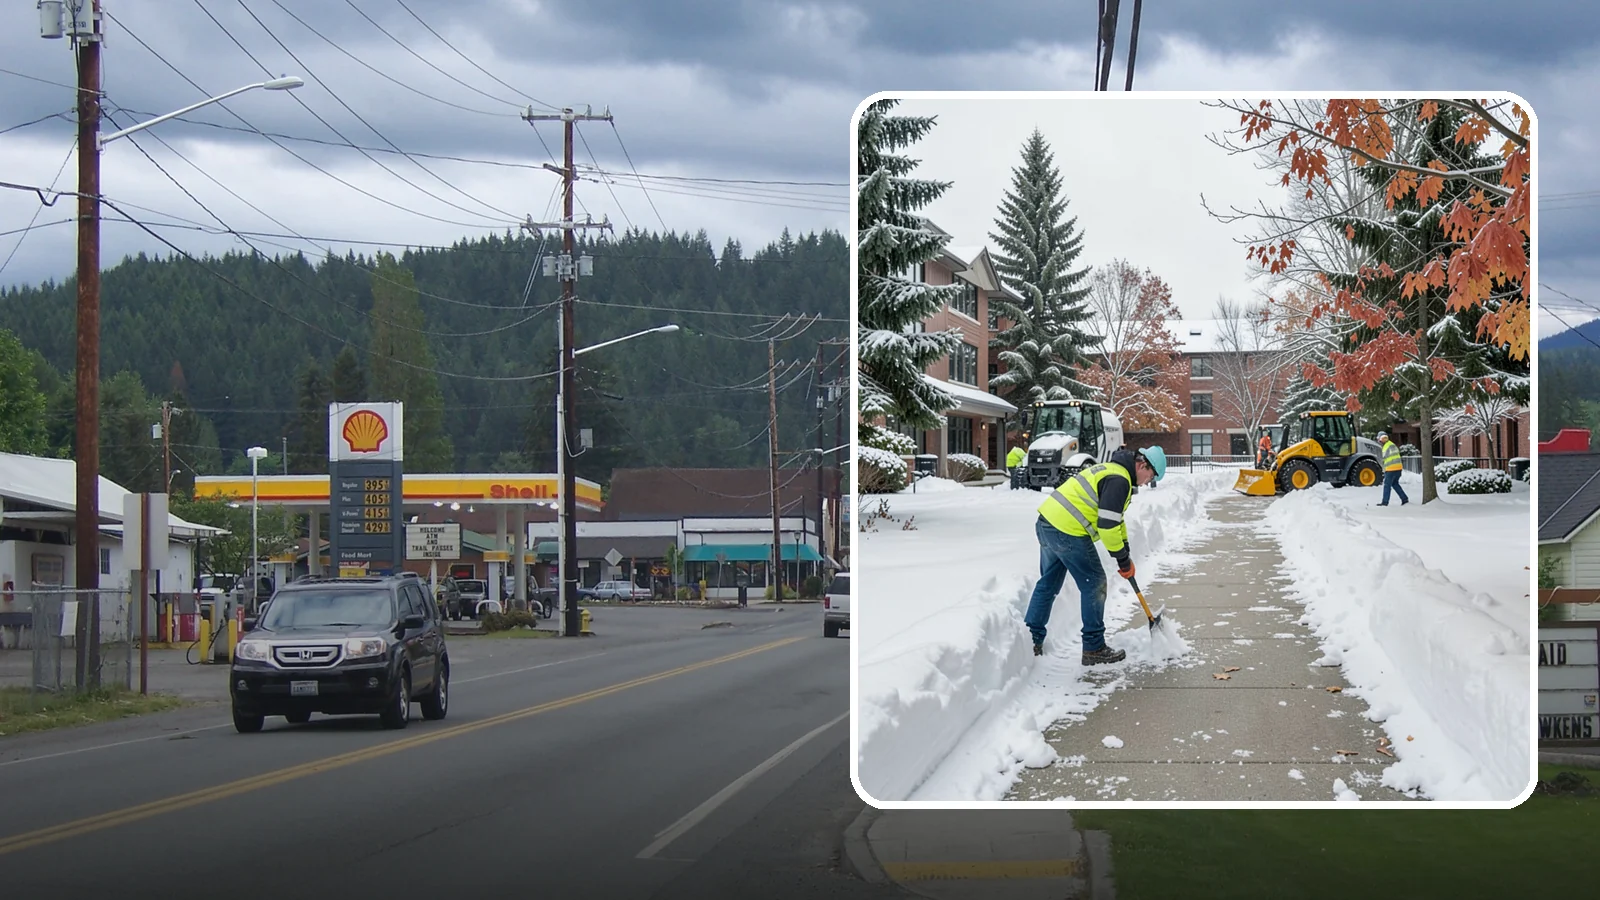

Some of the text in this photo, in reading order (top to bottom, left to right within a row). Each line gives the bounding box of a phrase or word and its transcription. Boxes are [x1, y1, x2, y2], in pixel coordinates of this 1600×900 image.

[366, 480, 383, 490] 395
[490, 484, 547, 499] Shell
[366, 494, 383, 504] 405
[366, 508, 383, 518] 415
[366, 522, 383, 532] 429
